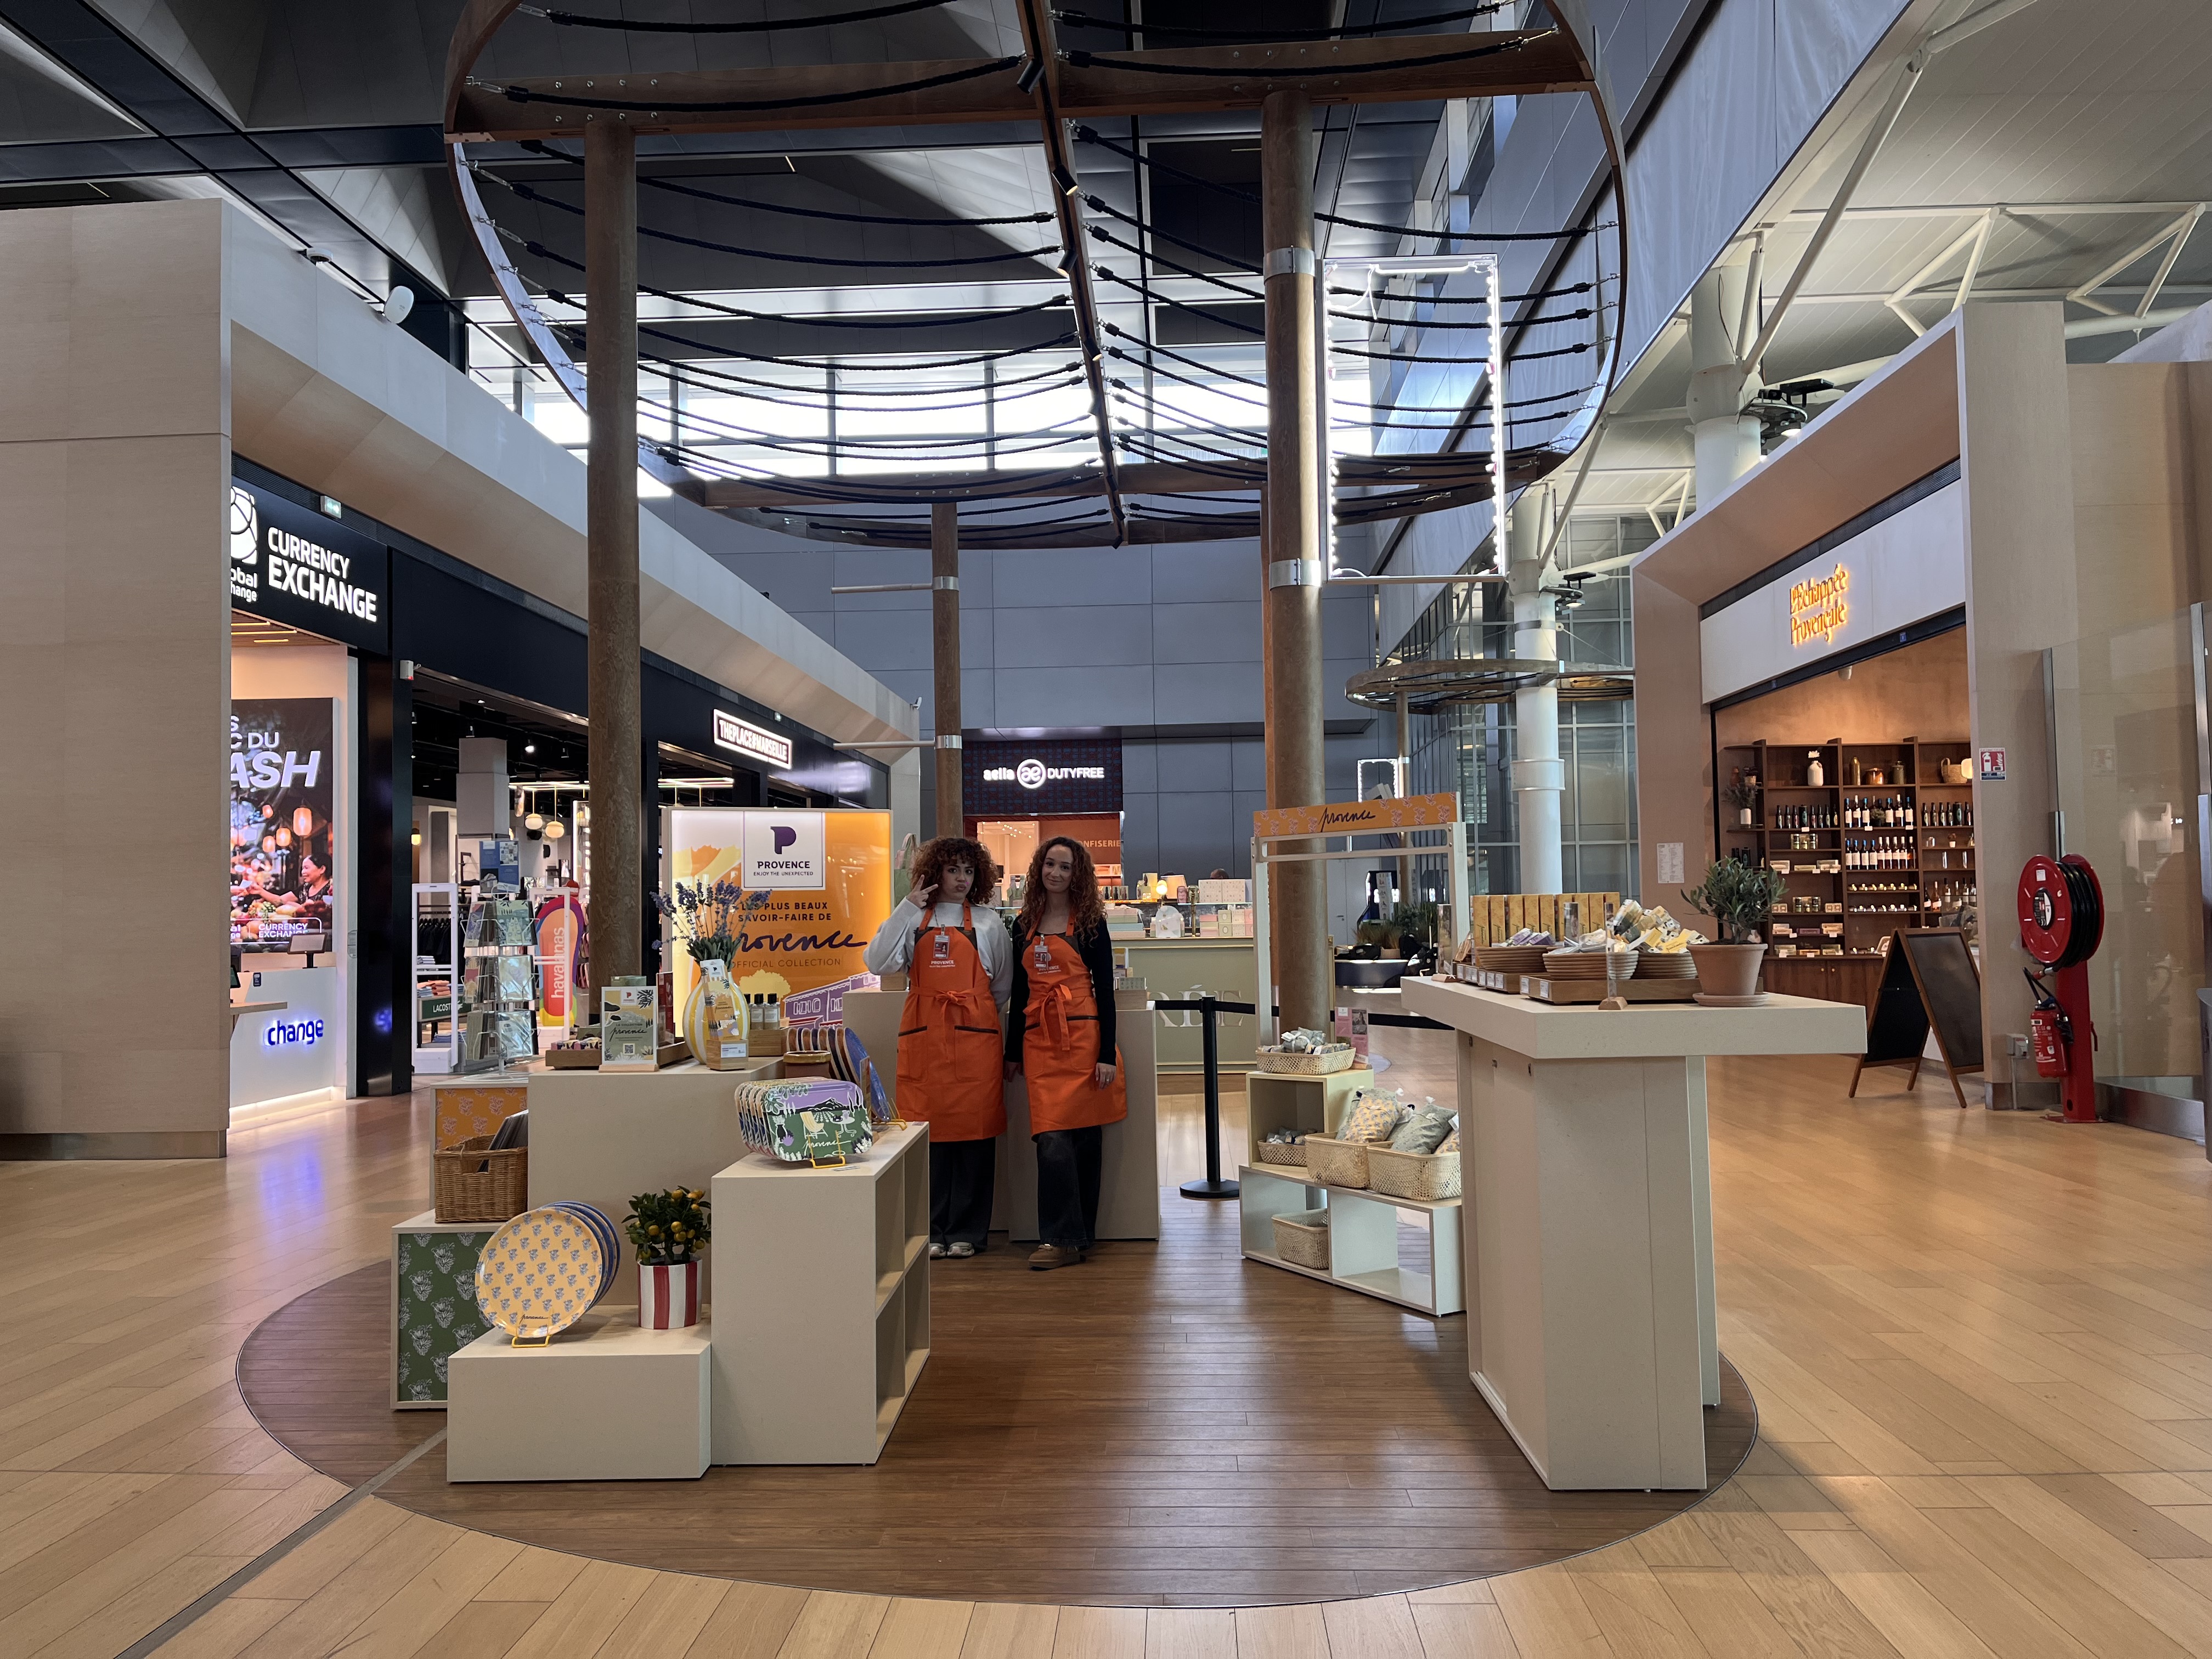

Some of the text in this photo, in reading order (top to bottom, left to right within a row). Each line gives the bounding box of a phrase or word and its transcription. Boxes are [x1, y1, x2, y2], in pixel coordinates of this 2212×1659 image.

[268, 527, 349, 579] CURRENCY
[268, 554, 377, 623] EXCHANGE
[248, 732, 279, 748] DU
[230, 750, 321, 788] ASH
[1318, 806, 1376, 833] provence
[742, 902, 758, 911] LS
[764, 902, 790, 911] PLUS
[738, 913, 814, 922] SAVOIR-FAIRE
[740, 930, 867, 952] rovence
[778, 958, 840, 967] COLLECTION
[433, 1003, 451, 1013] LACOST
[268, 1019, 324, 1046] change
[610, 1027, 647, 1042] provence
